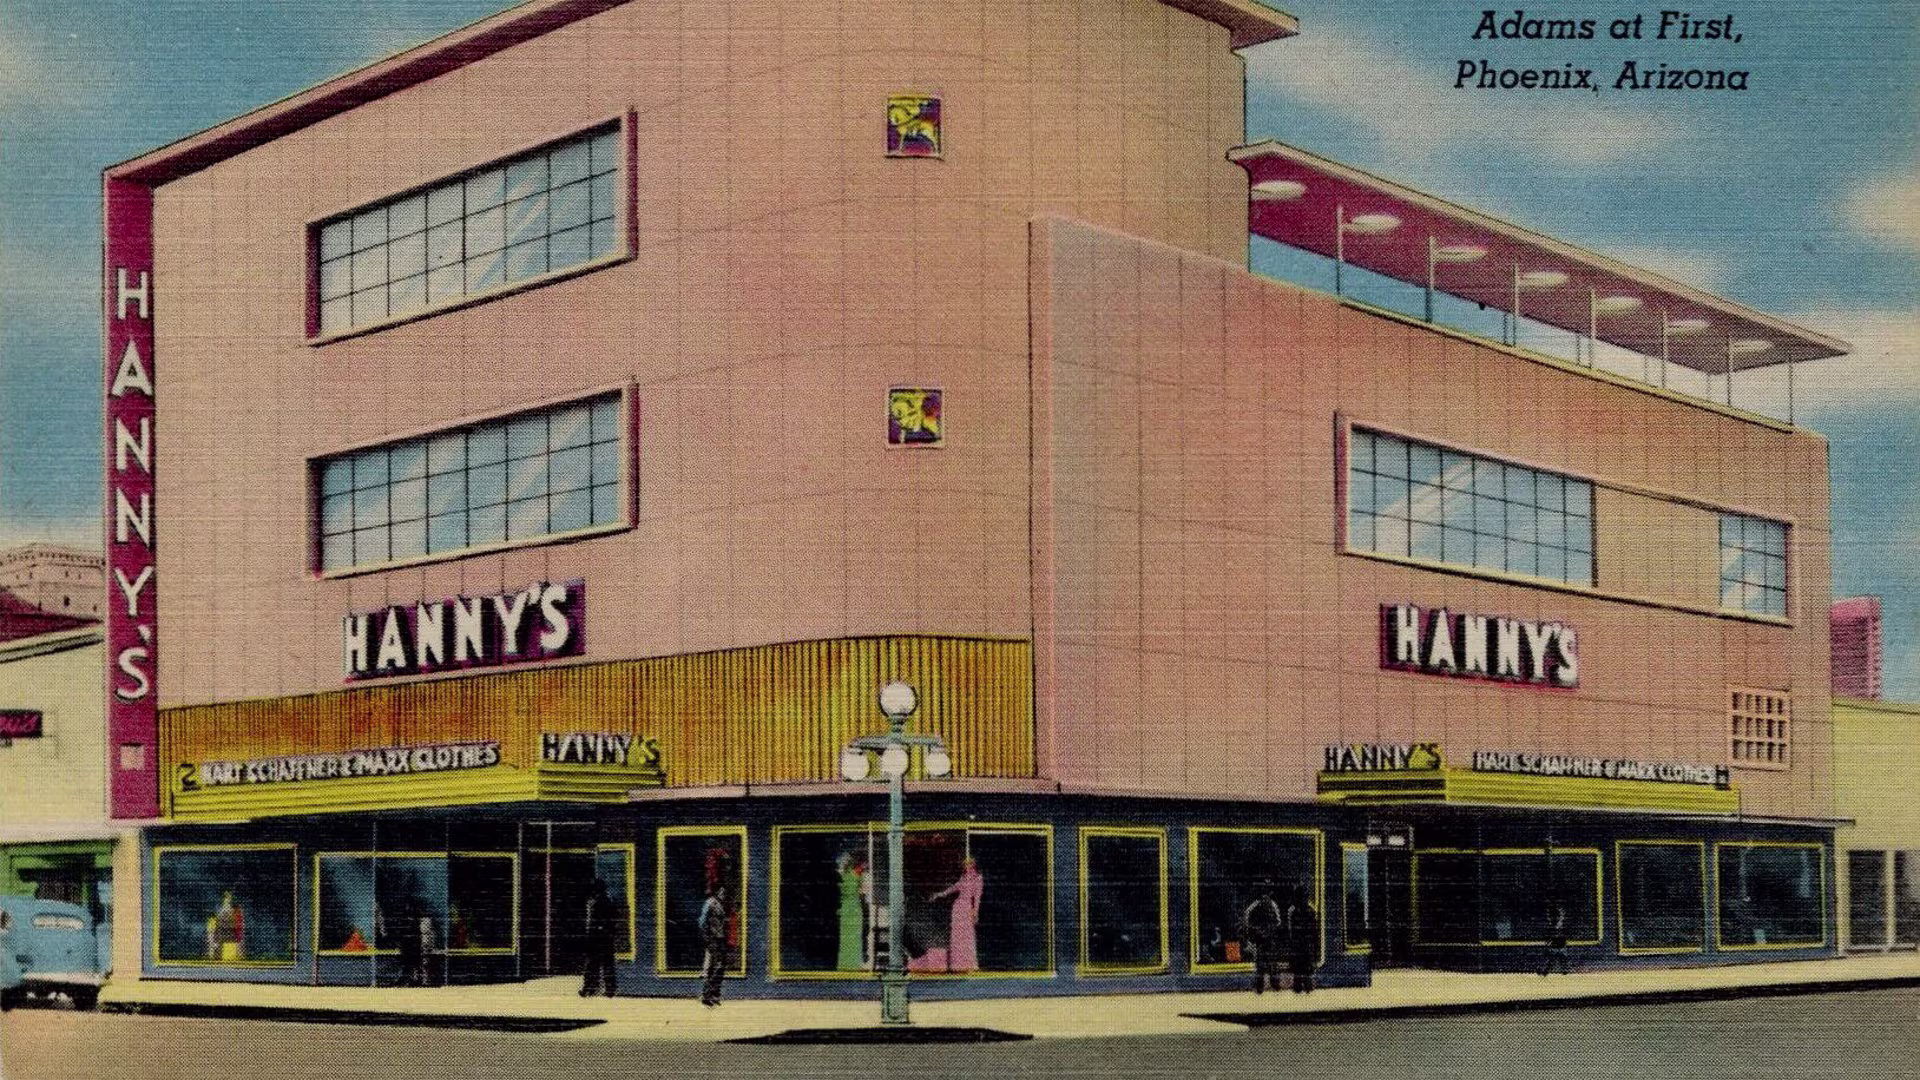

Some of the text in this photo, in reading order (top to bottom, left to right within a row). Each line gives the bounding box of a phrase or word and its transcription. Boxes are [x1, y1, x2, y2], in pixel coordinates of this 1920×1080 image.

[111, 267, 154, 699] HANNY'S
[342, 582, 571, 674] HANNY'S
[1396, 603, 1579, 688] HANNY'S
[354, 748, 409, 777] MARX
[410, 743, 499, 773] CLOTHES
[538, 732, 661, 766] HANNY'S
[1321, 743, 1441, 771] HANNY'S
